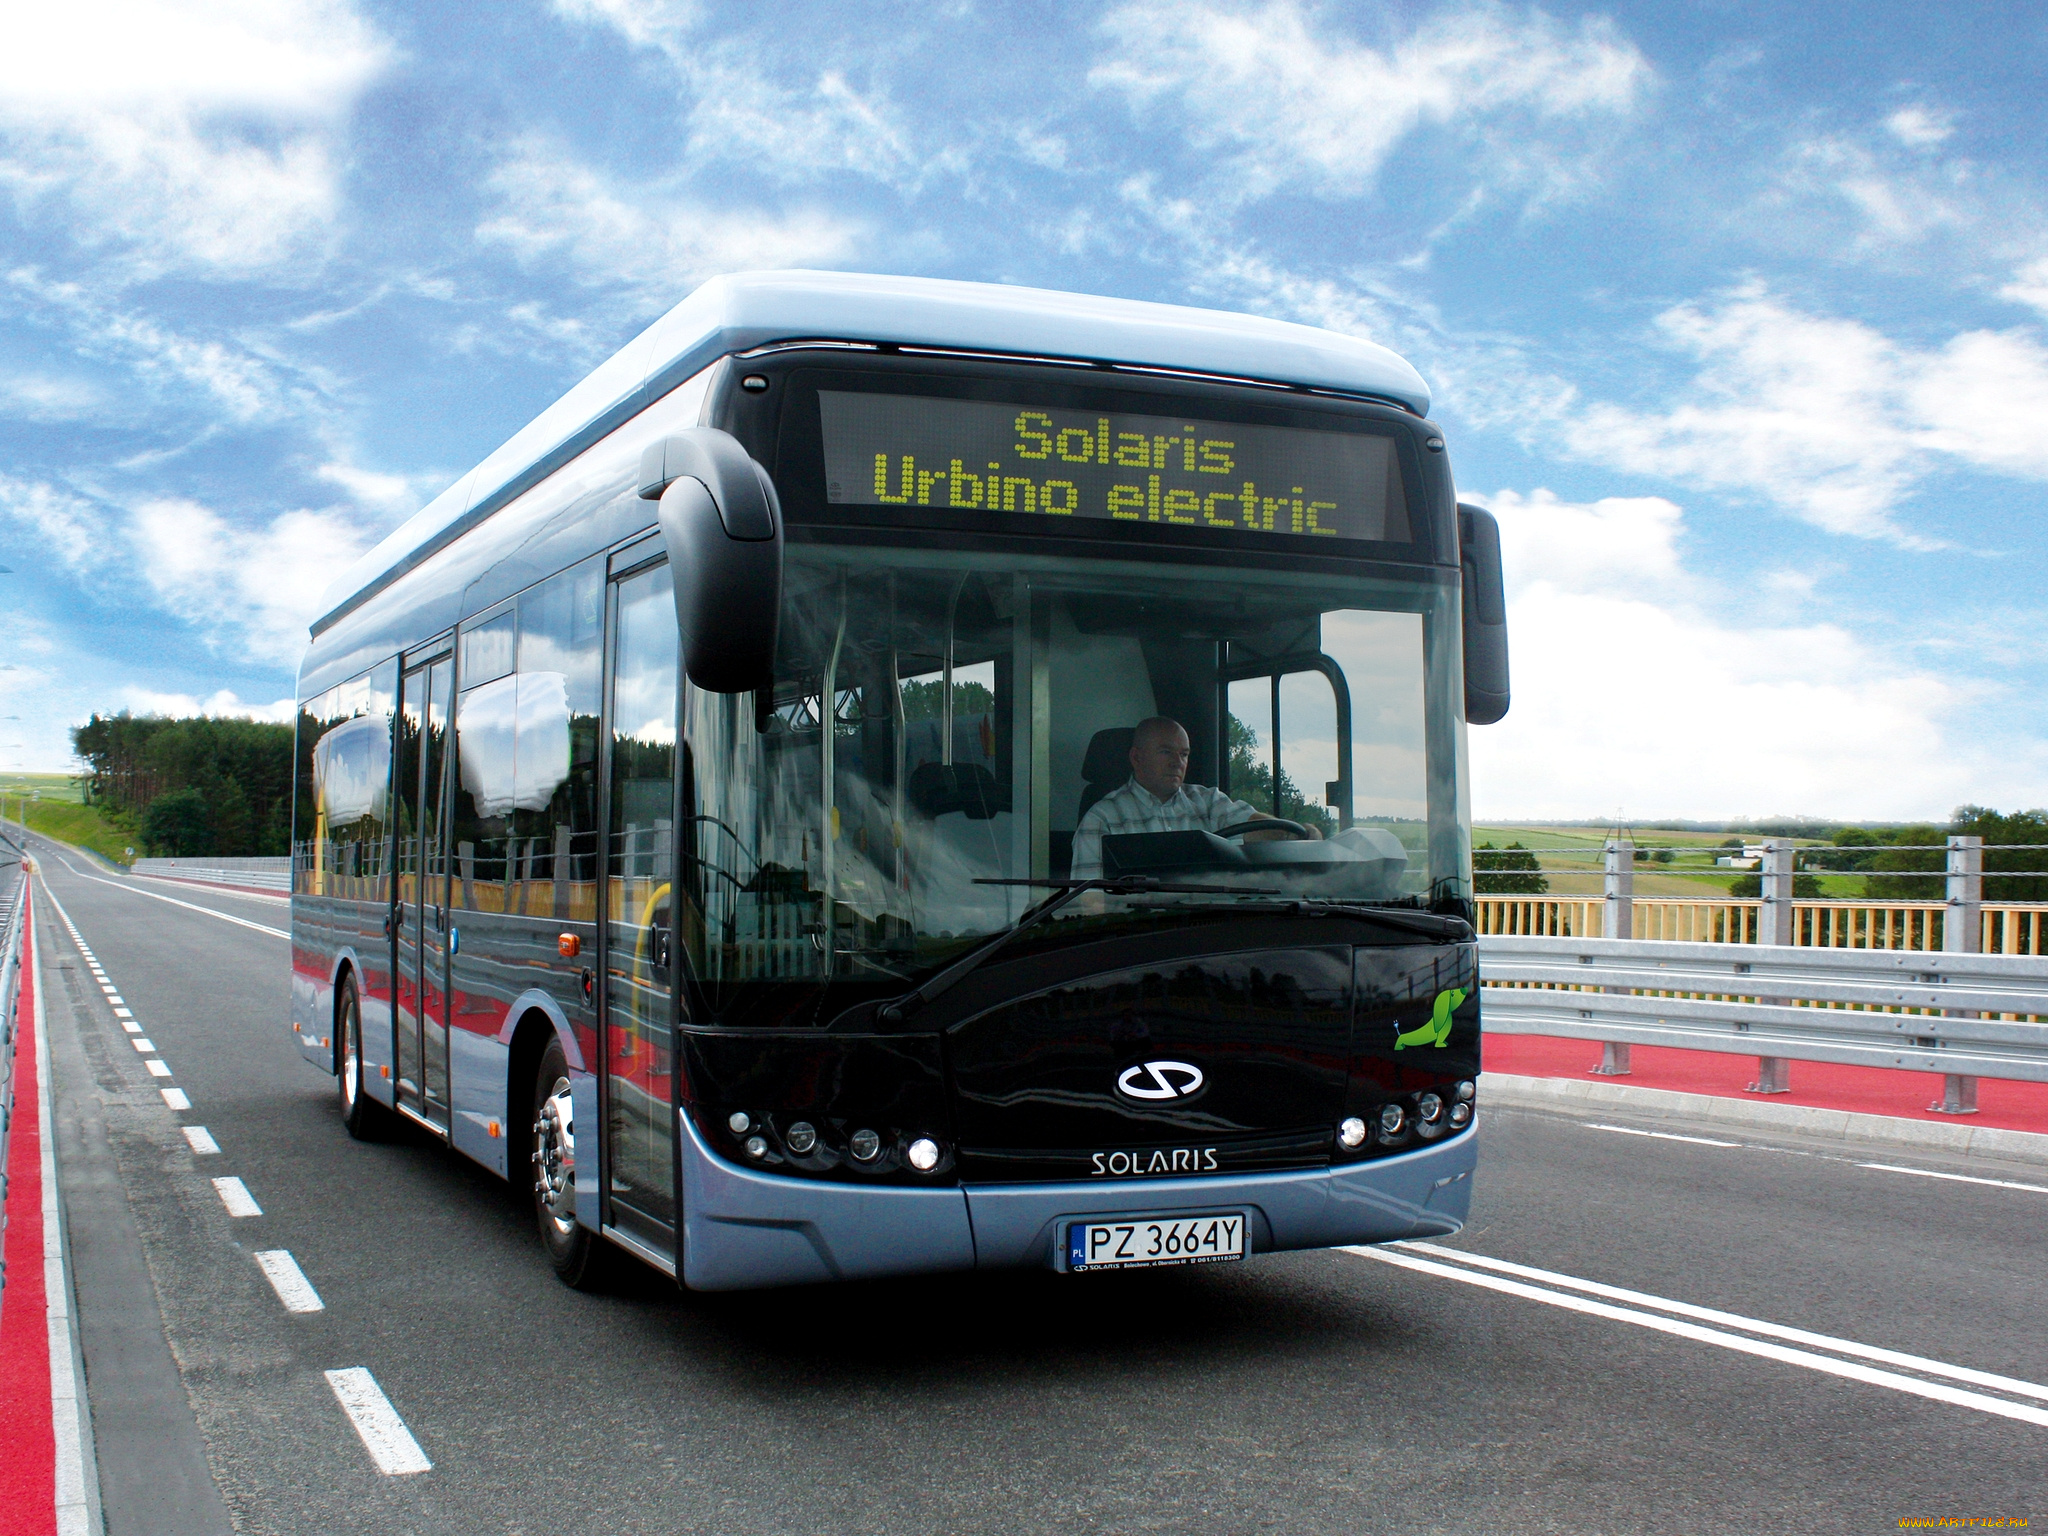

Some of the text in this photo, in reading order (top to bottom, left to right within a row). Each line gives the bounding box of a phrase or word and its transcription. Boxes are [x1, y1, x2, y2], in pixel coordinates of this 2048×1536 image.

[1013, 410, 1236, 475] Solaris
[873, 452, 1339, 537] Urbino electric
[1091, 1147, 1218, 1175] SOLARIS
[1072, 1248, 1084, 1258] PL
[1091, 1218, 1238, 1260] PZ 3664Y
